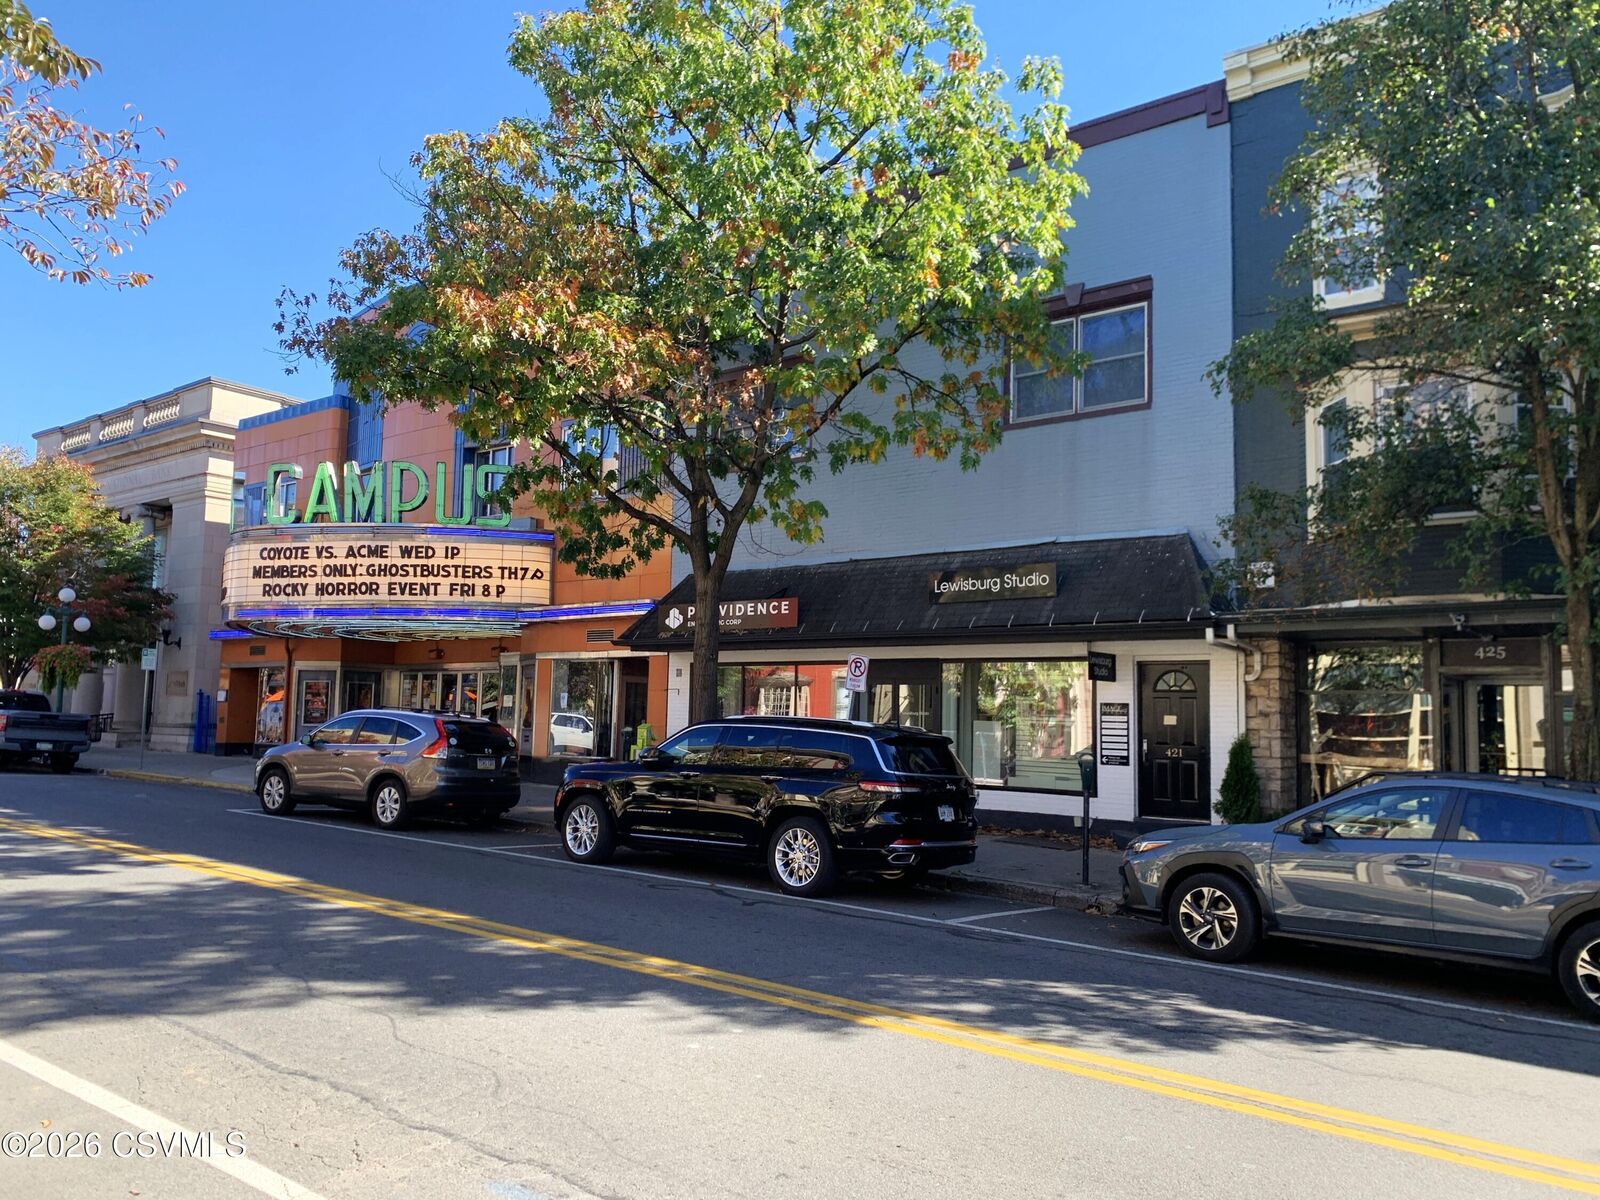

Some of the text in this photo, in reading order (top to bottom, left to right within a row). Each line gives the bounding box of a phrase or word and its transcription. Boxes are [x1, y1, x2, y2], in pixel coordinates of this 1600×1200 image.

[267, 461, 513, 527] CAMPUS
[259, 546, 310, 560] COYOTE
[315, 545, 338, 559] VS.
[345, 544, 390, 559] ACME
[399, 545, 436, 559] WED
[252, 565, 318, 579] MEMBERS
[366, 563, 493, 579] GHOSTBUSTERS
[262, 582, 506, 598] ROCKY HORROR EVENT FRI 8 P
[934, 572, 1050, 593] Lewisburg Studio
[687, 601, 790, 619] PVIDENCE
[1474, 645, 1507, 659] 425
[1165, 749, 1183, 758] 421
